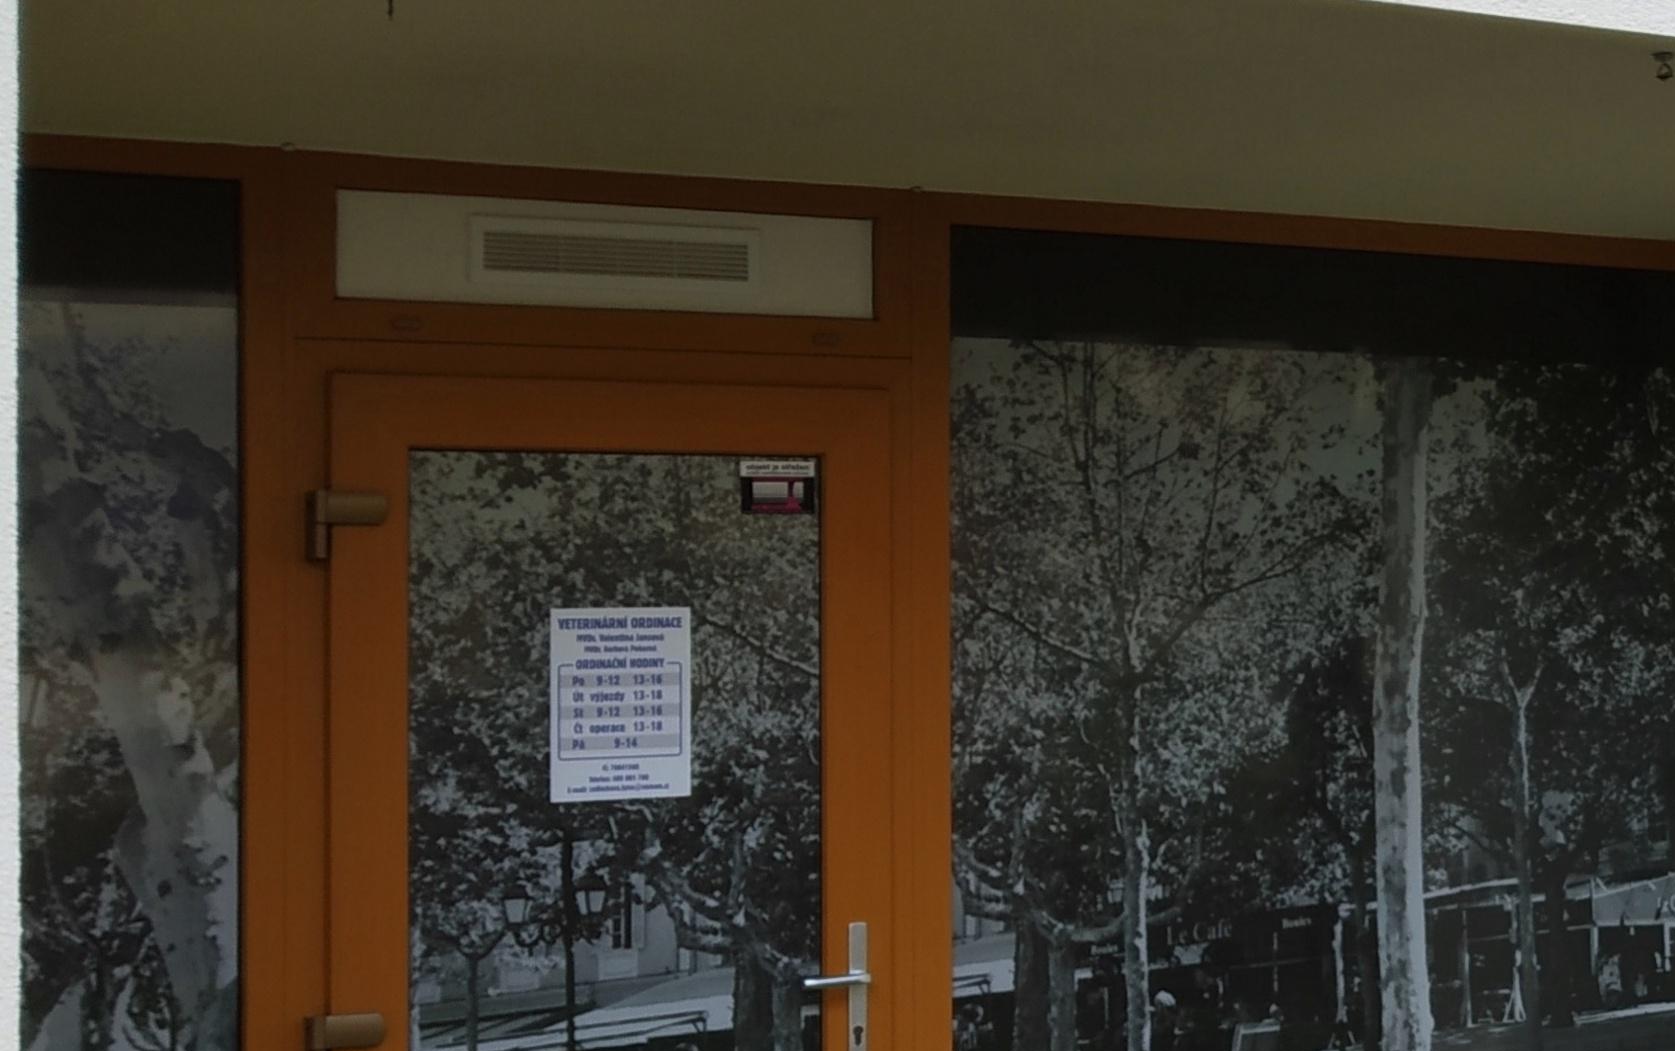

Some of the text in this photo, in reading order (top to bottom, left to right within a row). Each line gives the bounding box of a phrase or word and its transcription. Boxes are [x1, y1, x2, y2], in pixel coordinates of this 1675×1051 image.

[558, 616, 682, 630] VETERINÁRNÍ ORDINACE
[576, 657, 664, 670] ORDINAČNÍ HODINY
[572, 674, 663, 686] Po 9-12 13-16
[590, 691, 625, 702] výjezdy
[633, 690, 663, 700] 13-18
[573, 708, 583, 718] St
[597, 707, 620, 717] 9-12
[574, 721, 663, 734] Čt operace 13-18
[572, 737, 637, 749] Pá 9-14
